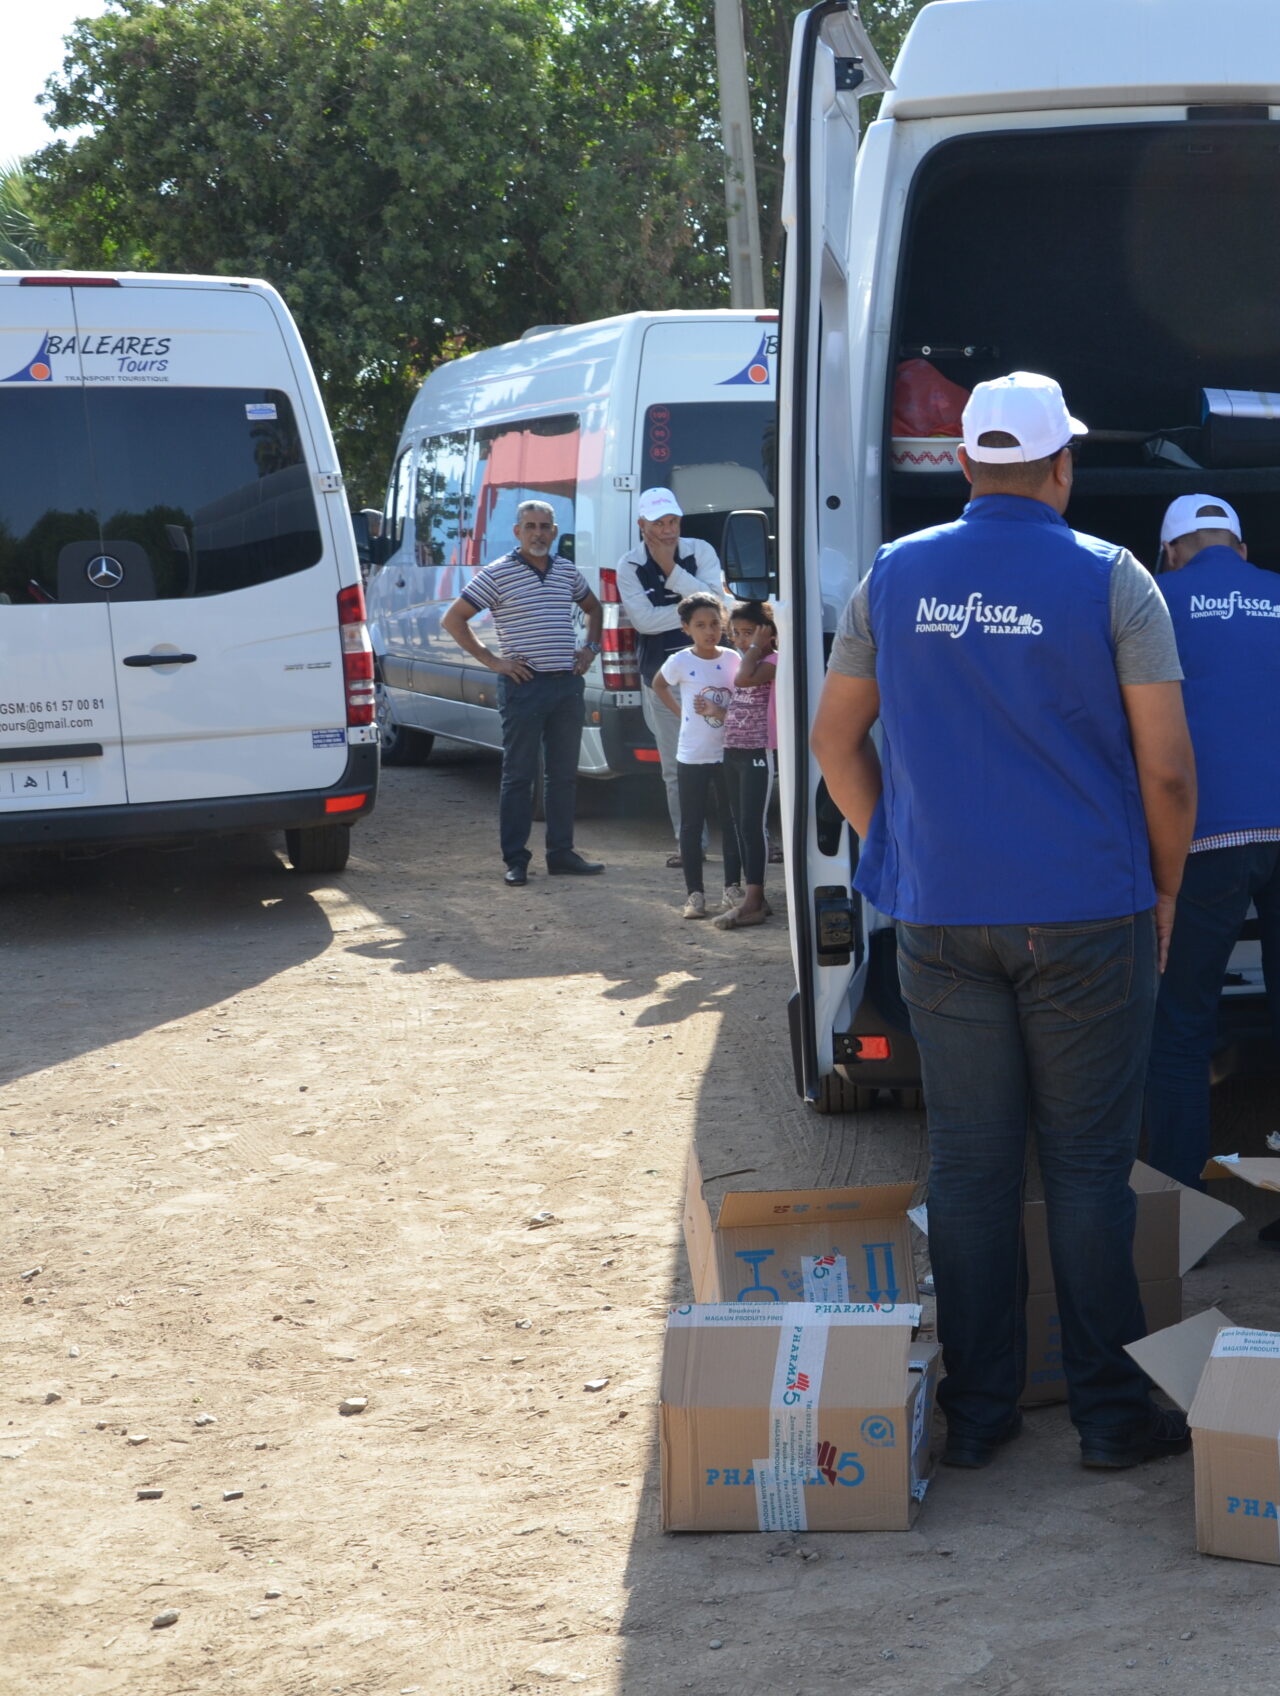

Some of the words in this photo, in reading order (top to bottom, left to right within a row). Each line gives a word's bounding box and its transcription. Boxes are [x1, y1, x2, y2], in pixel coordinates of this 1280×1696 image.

[46, 335, 172, 356] BALEARES
[117, 356, 169, 373] Tours
[916, 592, 1018, 639] Noufissa
[1190, 590, 1272, 620] Noufissa
[1191, 610, 1228, 619] FONDATION
[915, 623, 960, 633] FONDATION
[46, 701, 58, 712] 61
[62, 700, 74, 711] 57
[77, 699, 90, 710] 00
[93, 698, 105, 710] 81
[786, 1326, 803, 1386] PHARMA
[836, 1451, 866, 1488] 5
